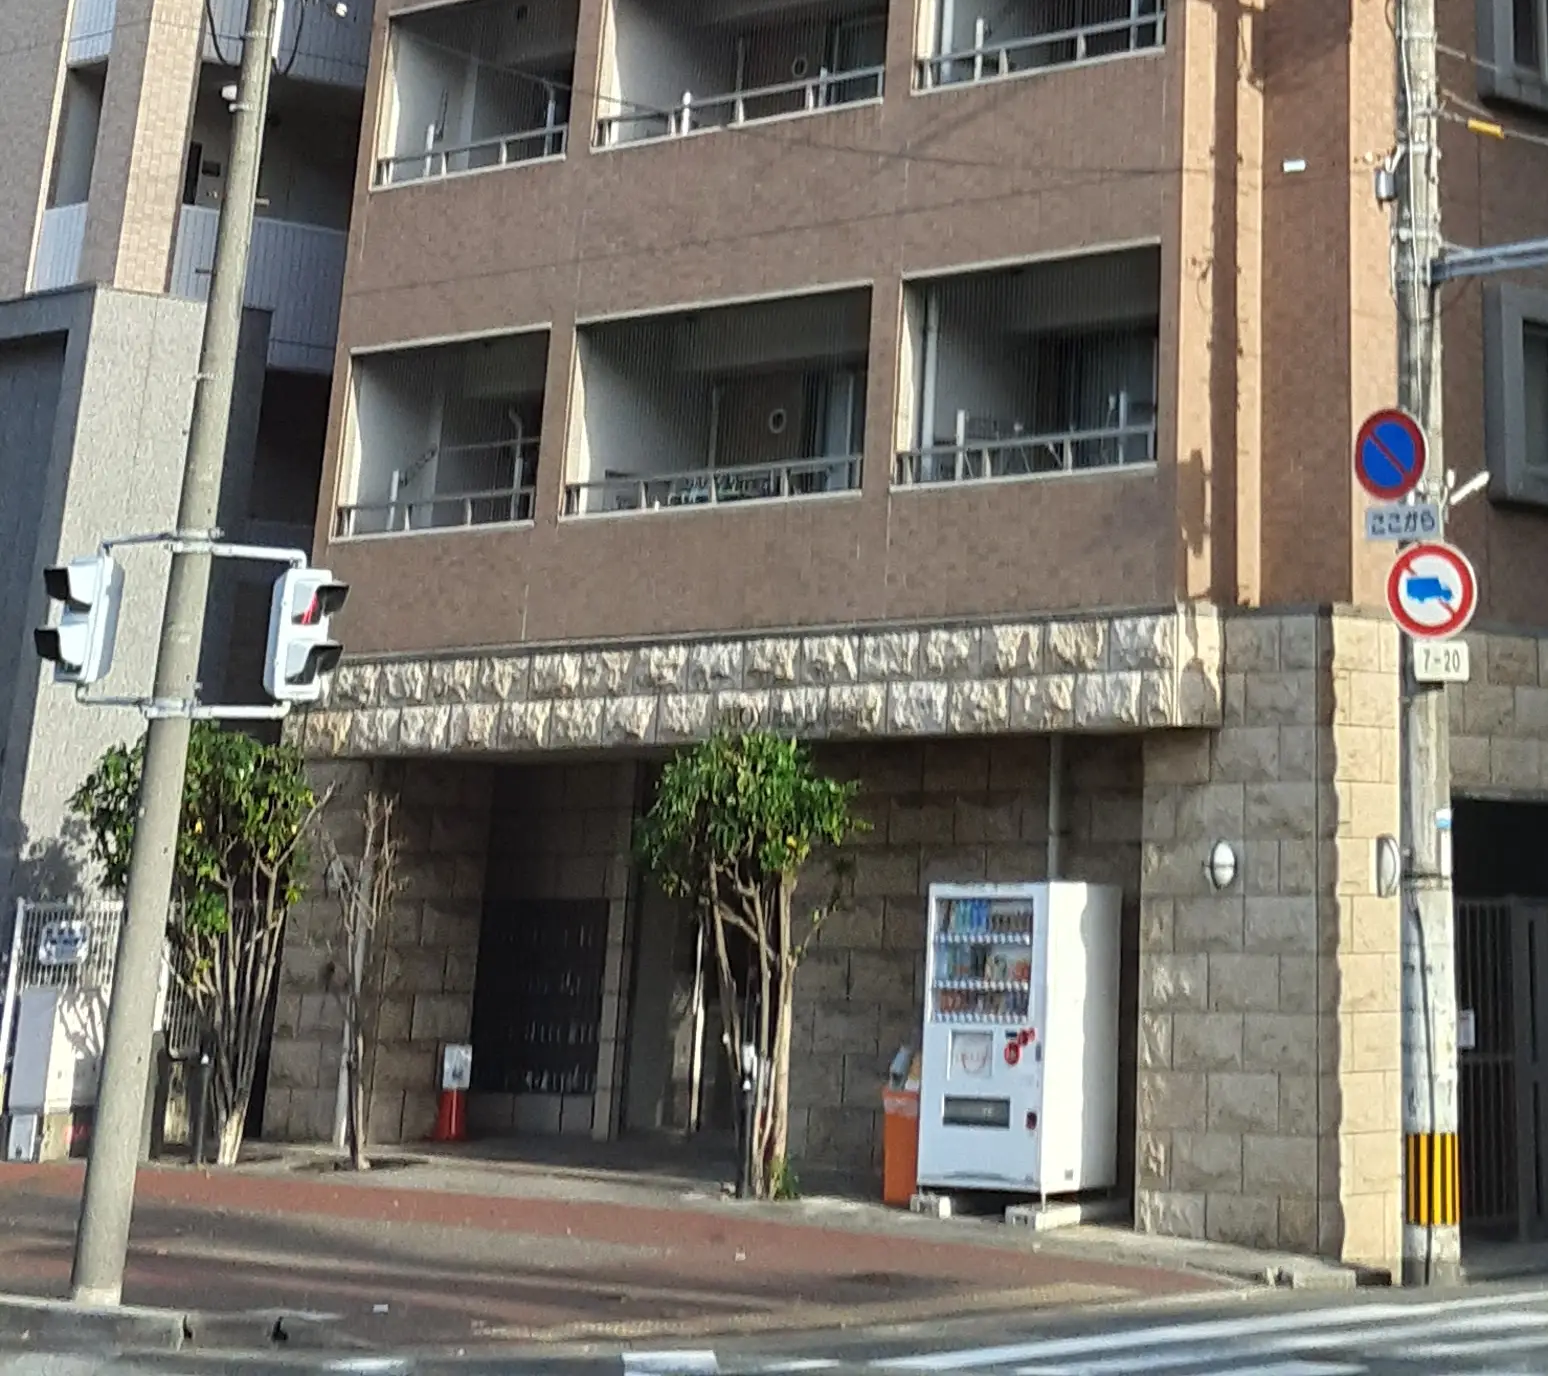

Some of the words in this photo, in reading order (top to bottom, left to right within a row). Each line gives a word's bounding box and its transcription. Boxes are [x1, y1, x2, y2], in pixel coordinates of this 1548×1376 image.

[1370, 509, 1436, 536] ここから
[1423, 649, 1461, 673] 7-20
